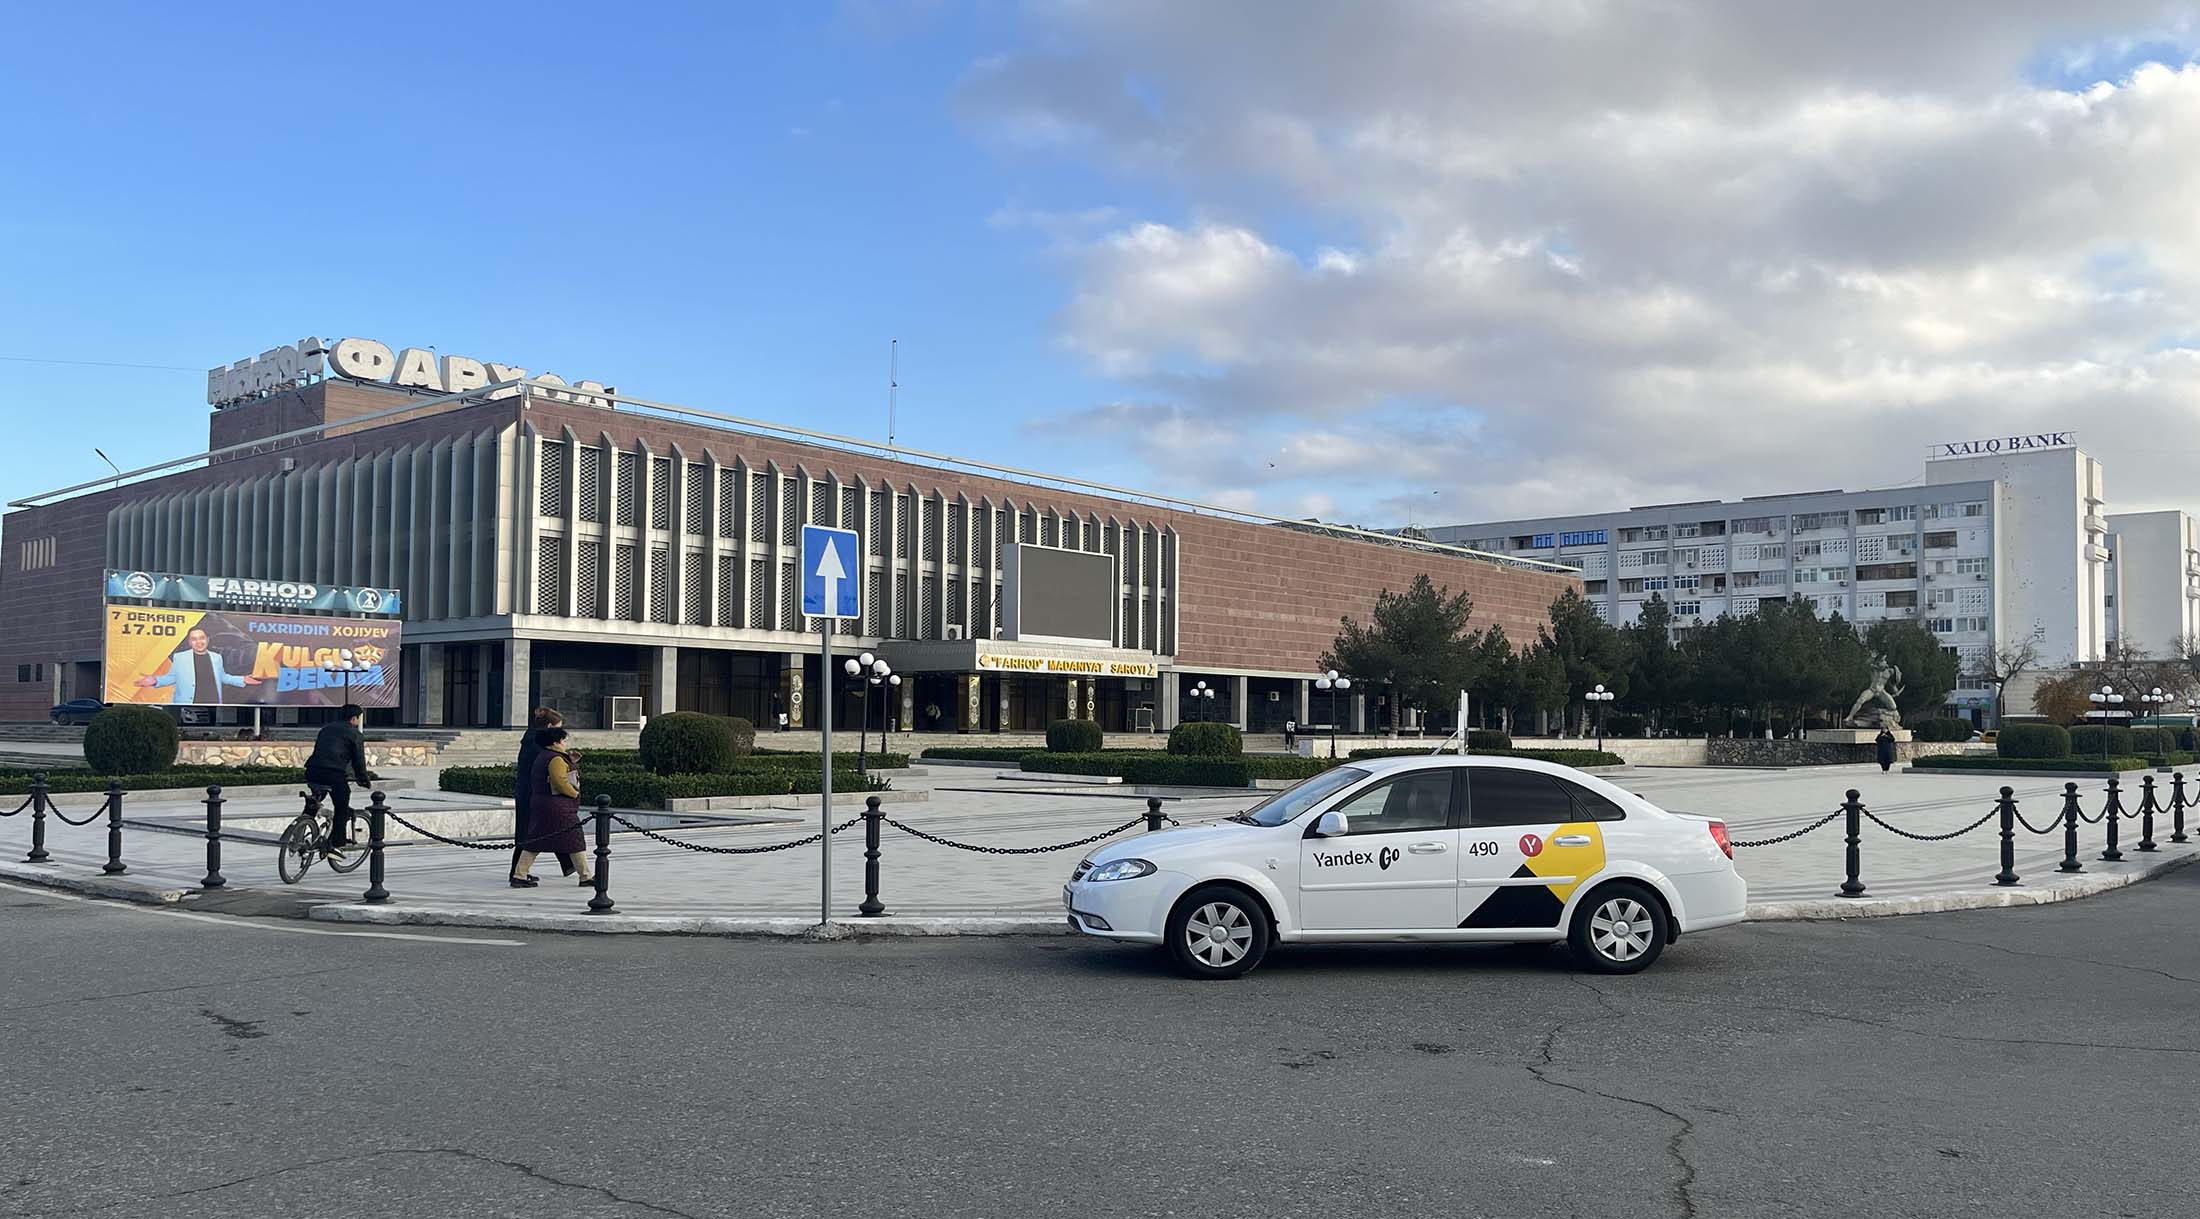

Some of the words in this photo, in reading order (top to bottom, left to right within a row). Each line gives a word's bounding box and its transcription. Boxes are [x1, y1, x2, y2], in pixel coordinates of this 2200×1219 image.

[1944, 438, 2001, 456] XALQ
[2008, 432, 2067, 450] BANK
[208, 578, 317, 599] FARHOD
[112, 611, 121, 620] 7
[127, 612, 186, 624] DEKABR
[122, 623, 176, 636] 17.00
[248, 622, 329, 635] FAXRIDDIN
[332, 626, 389, 638] XOJIYEV
[252, 641, 342, 679] KULGI
[991, 656, 1044, 670] "FARHOD"
[1047, 660, 1104, 673] MADANIYAT
[1110, 663, 1146, 676] SAROYI
[1469, 841, 1499, 856] 490
[1524, 837, 1537, 854] Y
[1313, 850, 1373, 867] Yandex
[1379, 846, 1400, 871] Go
